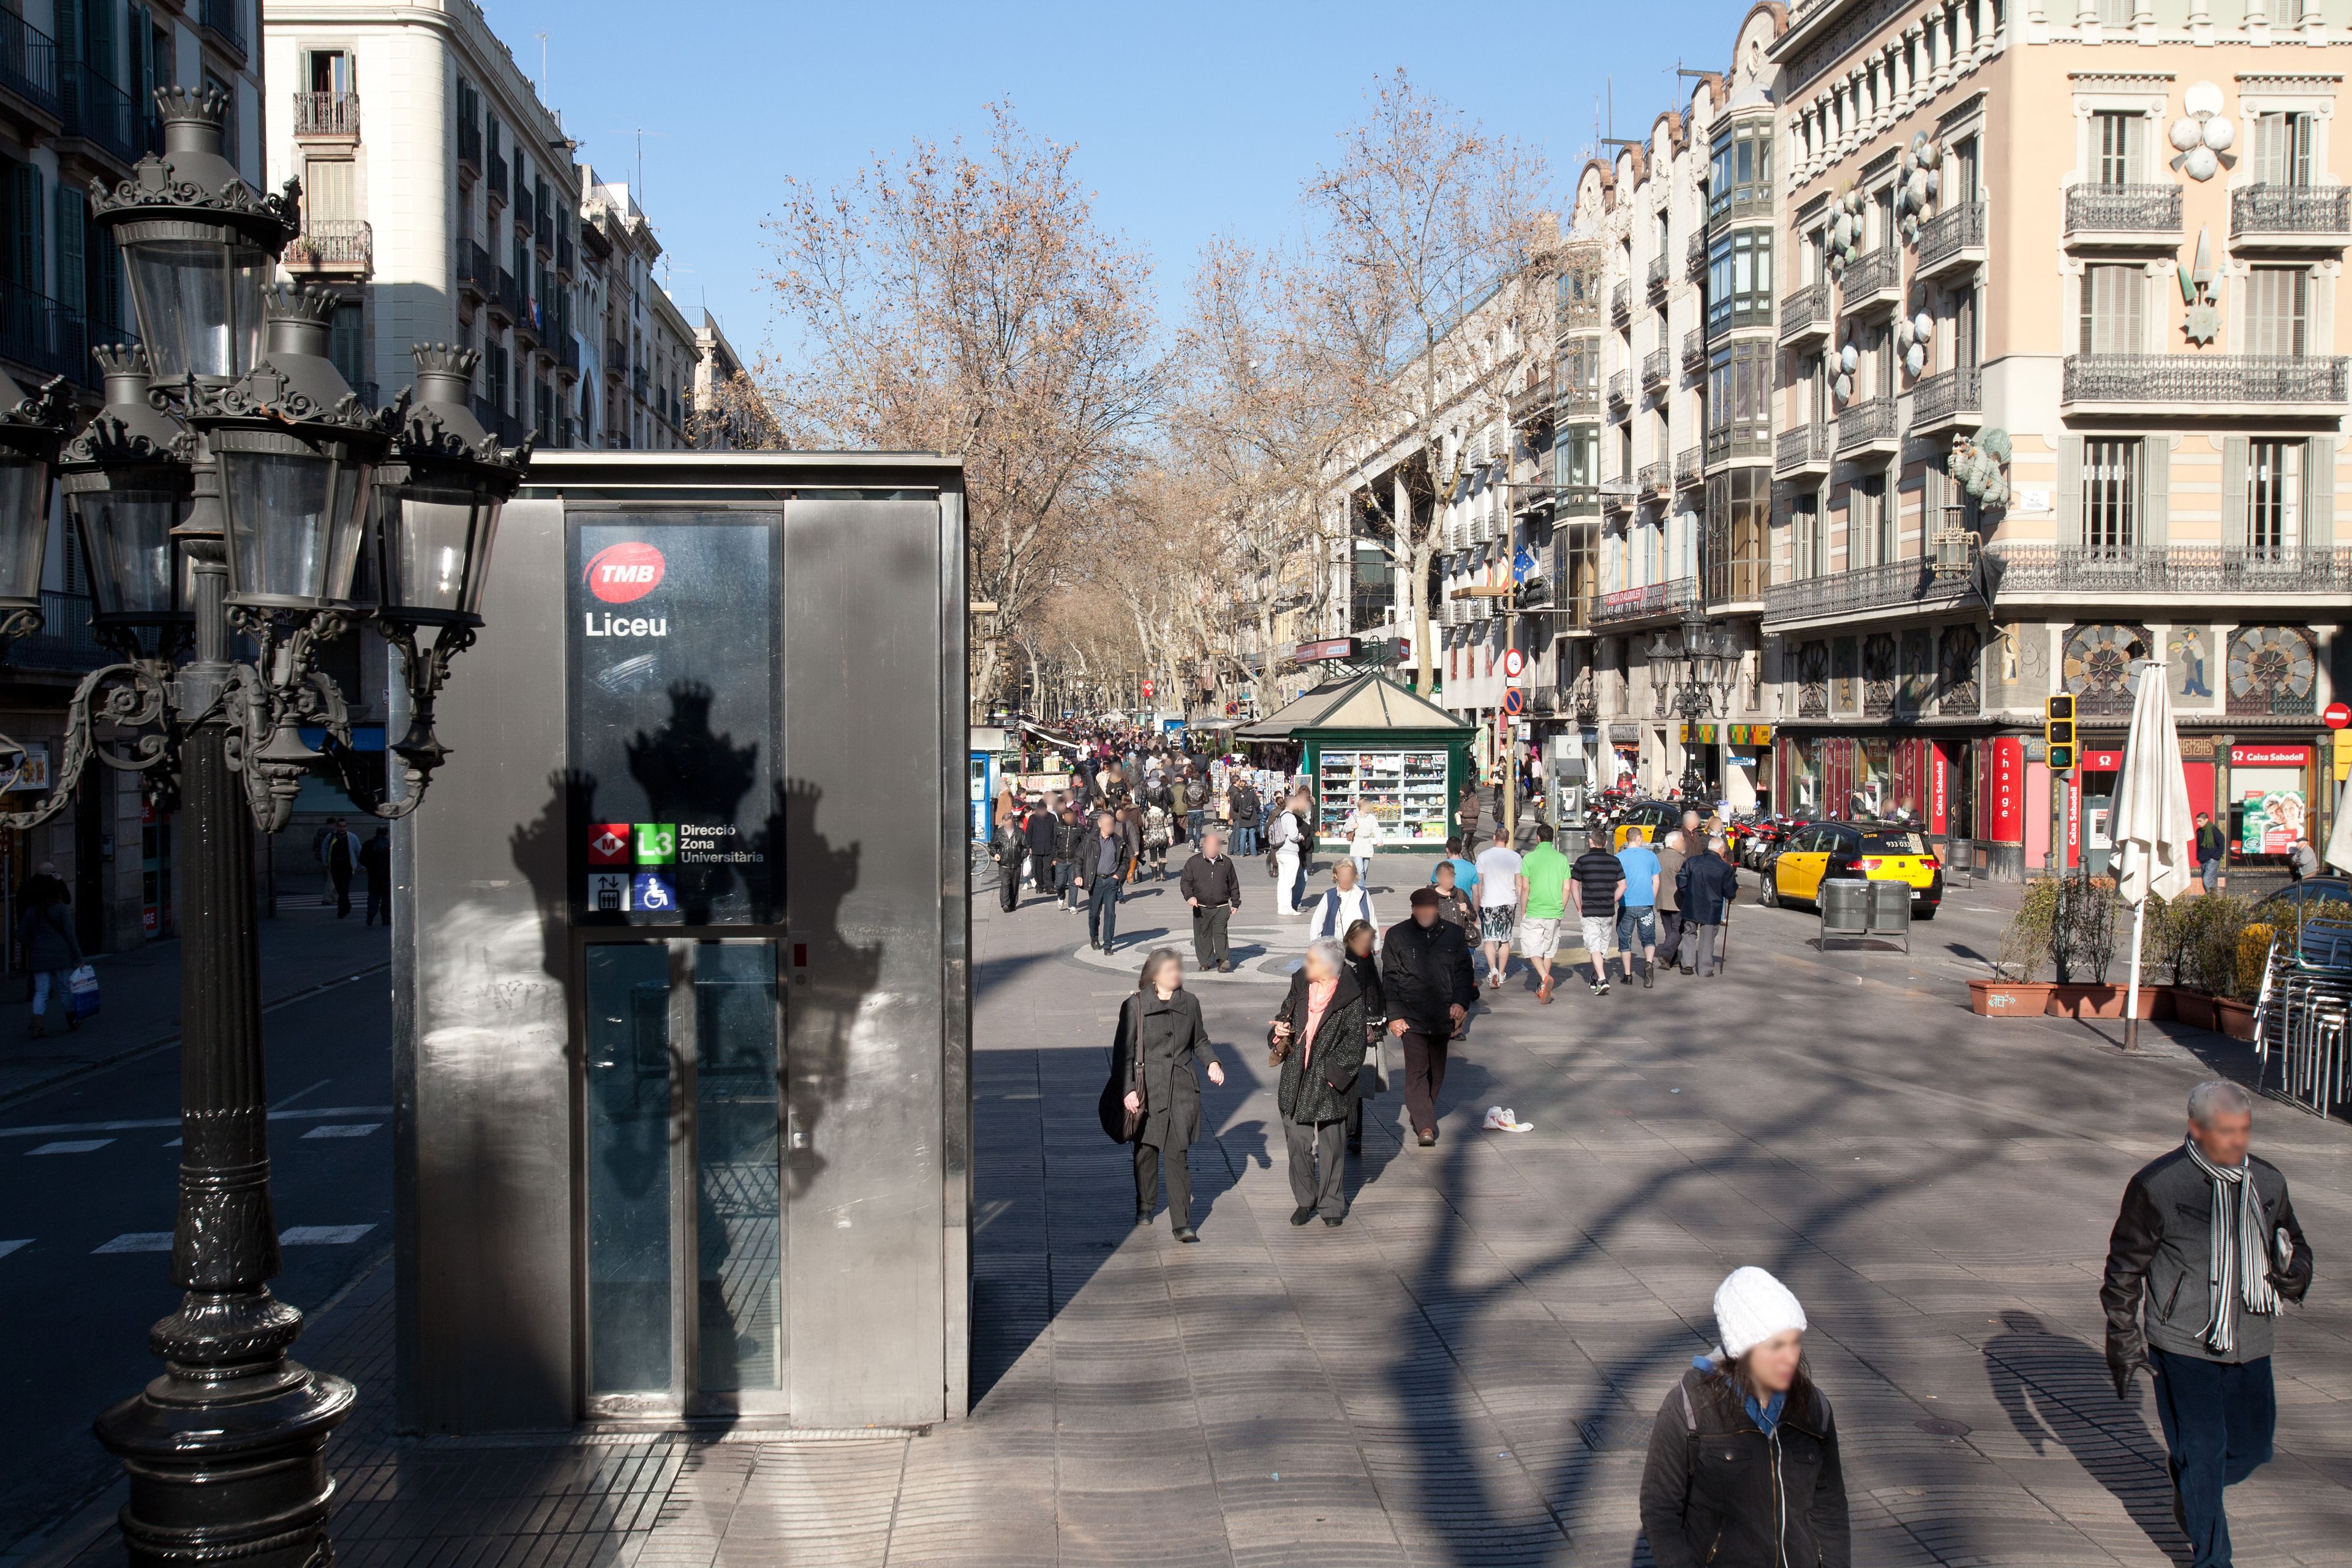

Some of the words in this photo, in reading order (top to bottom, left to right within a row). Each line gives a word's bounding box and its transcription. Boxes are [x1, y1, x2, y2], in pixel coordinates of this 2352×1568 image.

[601, 565, 655, 582] TMB
[1623, 589, 1642, 601] ALQUILER
[1607, 606, 1613, 616] 93
[1614, 603, 1624, 614] 481
[1626, 602, 1631, 612] 71
[1633, 600, 1640, 611] 71
[586, 612, 666, 636] Liceu
[601, 839, 616, 850] M
[638, 832, 673, 856] L3
[680, 824, 736, 835] Direcció
[680, 838, 715, 850] Zona
[680, 851, 764, 863] Universitària
